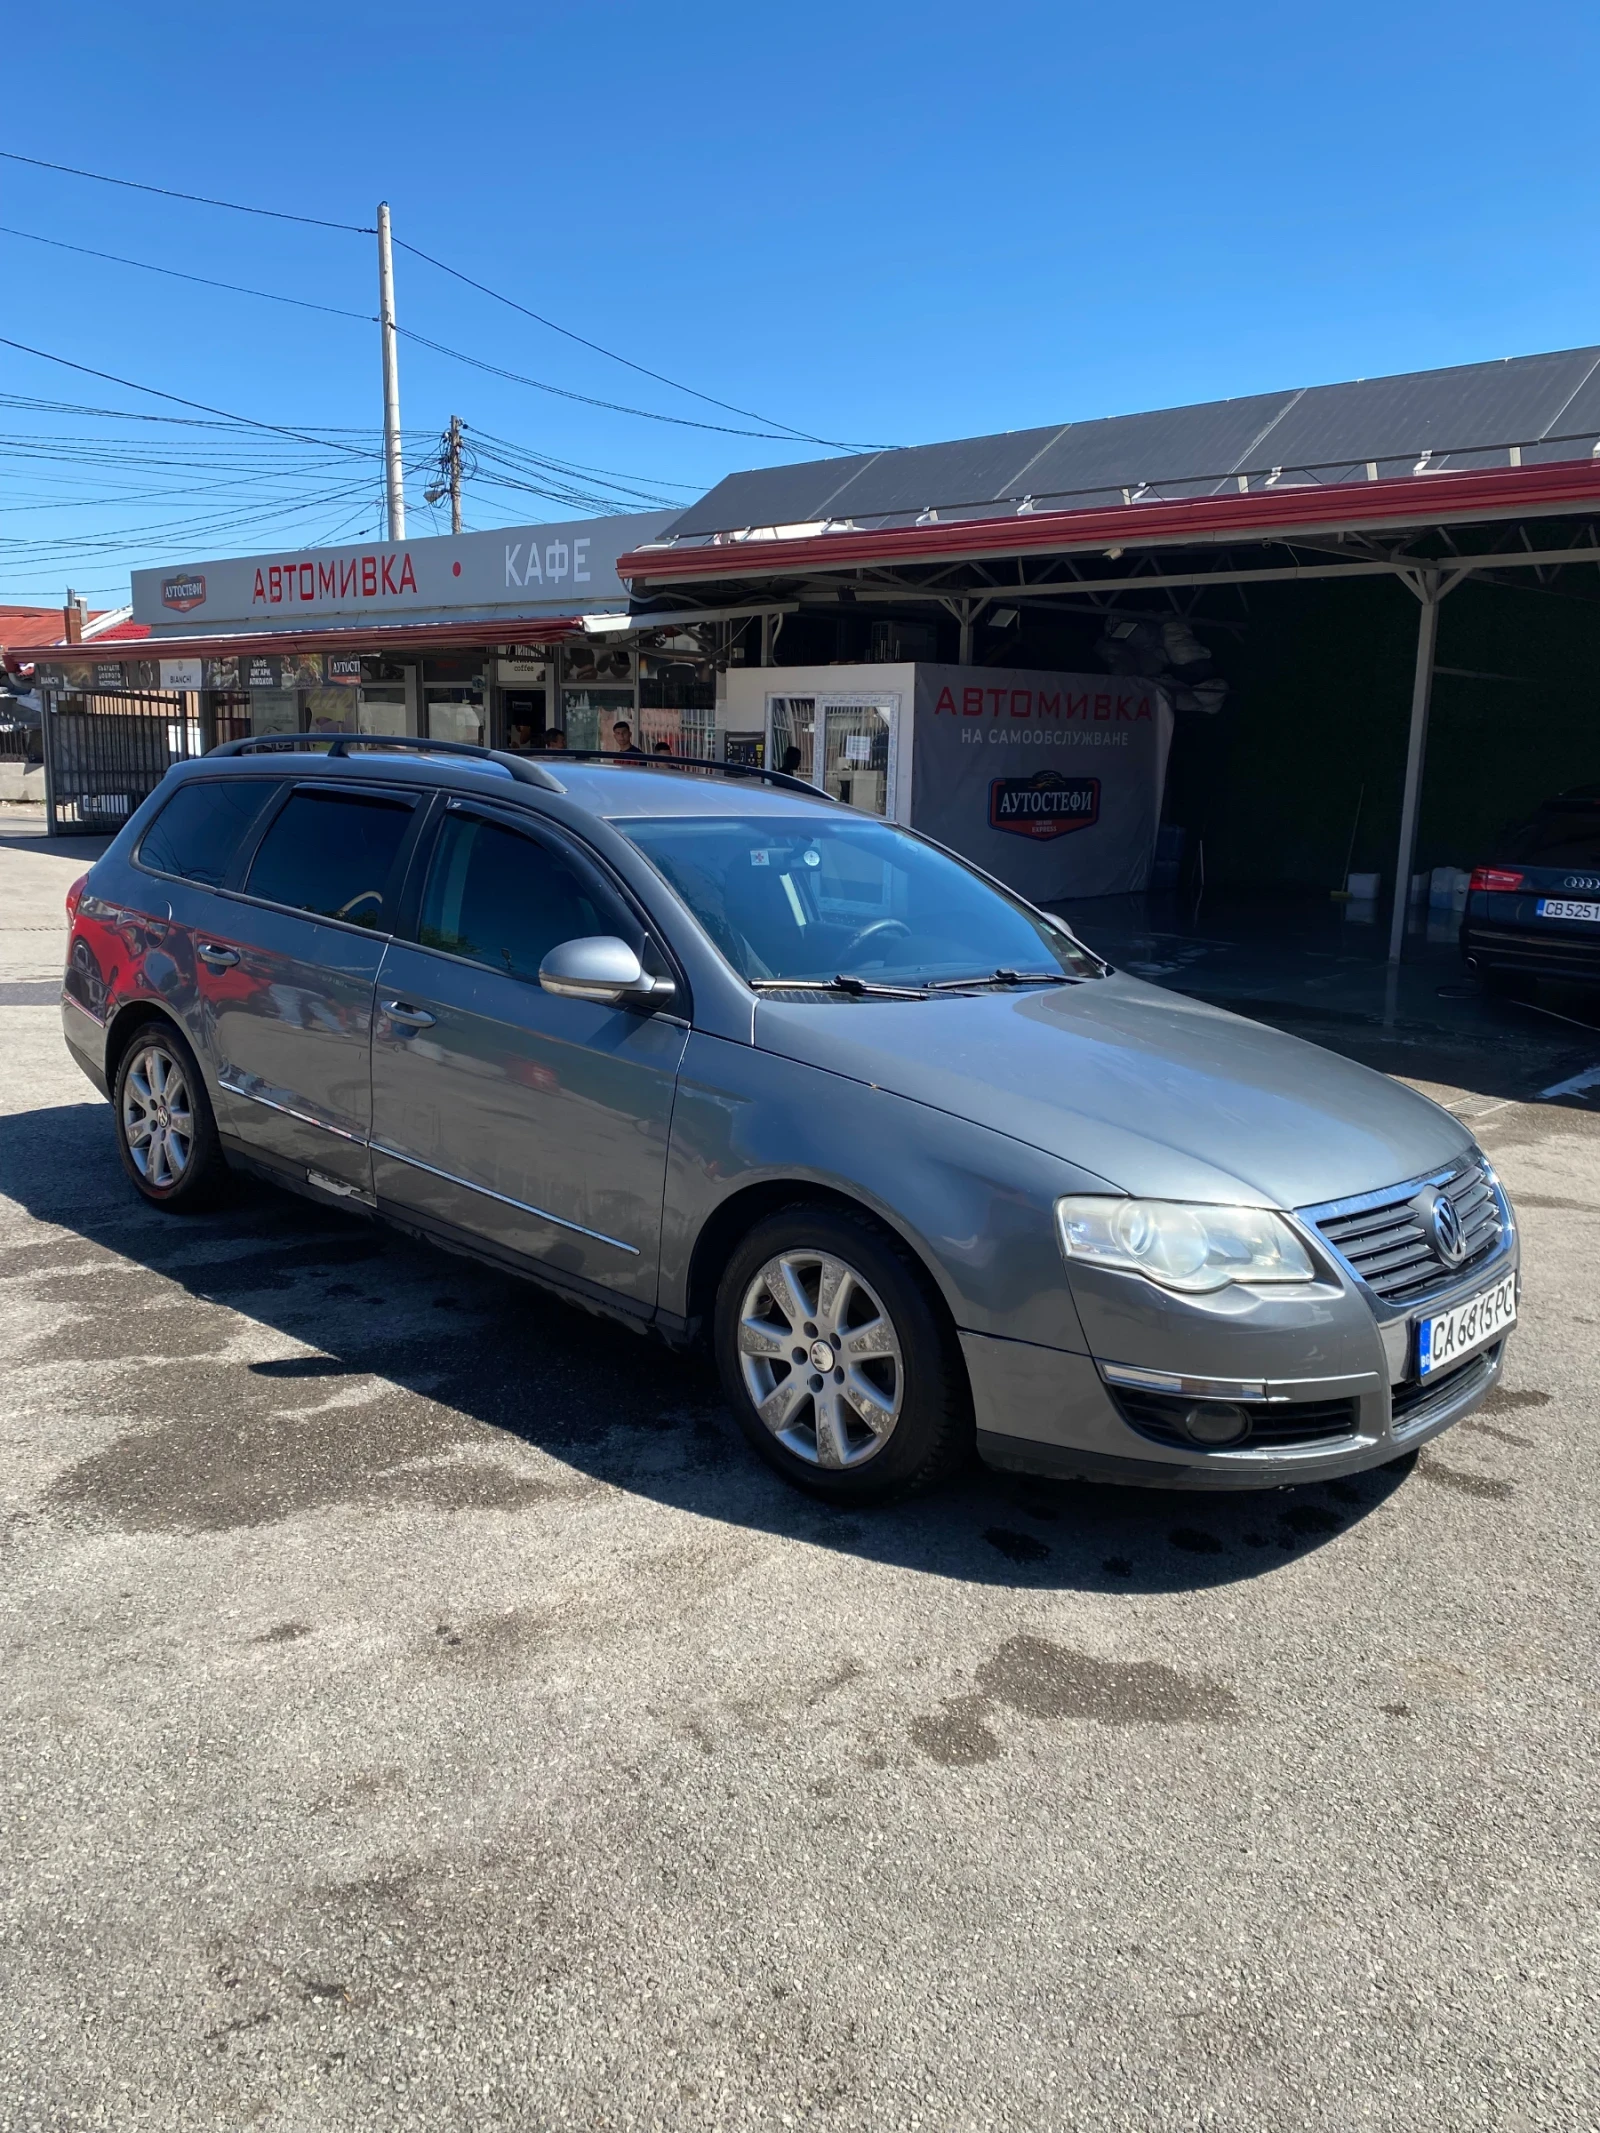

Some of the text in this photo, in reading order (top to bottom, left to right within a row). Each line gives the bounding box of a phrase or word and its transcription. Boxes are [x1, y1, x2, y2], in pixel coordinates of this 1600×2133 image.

[505, 538, 591, 587] КАФЕ
[252, 553, 417, 604] АВТОМИВКА
[165, 583, 202, 598] АУТОСТЕФИ
[252, 659, 267, 667] КАФЕ
[513, 664, 535, 672] coffee
[40, 676, 60, 685] BIANCHI
[169, 674, 192, 684] BIANCHI
[934, 686, 1153, 721] АВТОМИВКА
[961, 728, 1129, 746] НА САМООБСЛУЖВАНЕ
[1000, 791, 1093, 813] АУТОСТЕФИ
[1031, 825, 1057, 833] EXPRESS
[1546, 902, 1563, 916] CB
[1433, 1316, 1455, 1361] CA
[1420, 1354, 1430, 1368] BG
